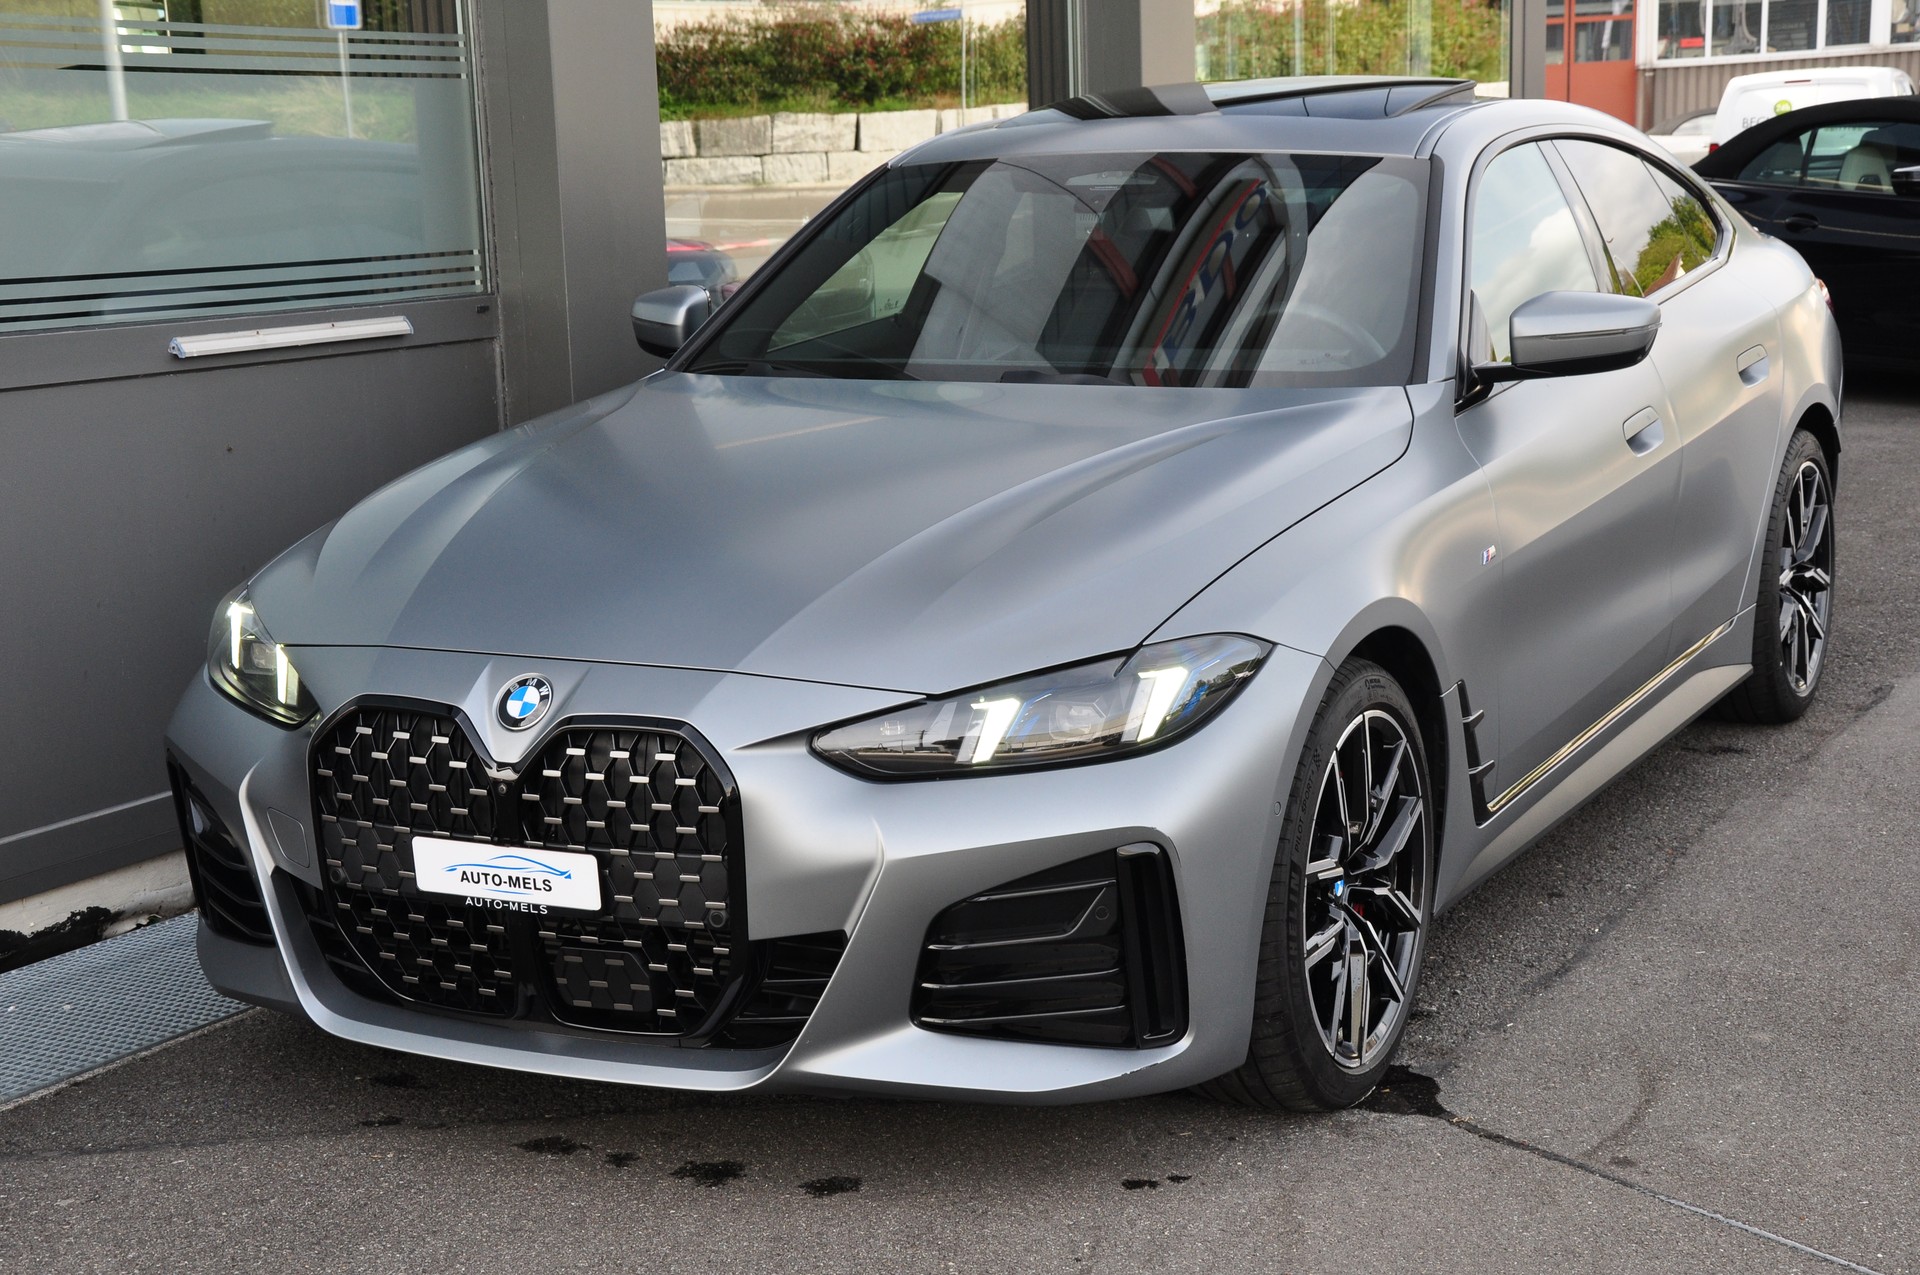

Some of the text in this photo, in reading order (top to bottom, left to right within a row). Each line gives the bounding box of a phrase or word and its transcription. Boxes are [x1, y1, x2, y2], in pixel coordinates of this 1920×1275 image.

[1162, 187, 1269, 362] BDO
[509, 678, 550, 696] BMW
[1294, 816, 1304, 853] PILOT
[460, 870, 553, 892] AUTO-MELS
[465, 896, 549, 915] AUTO-MELS
